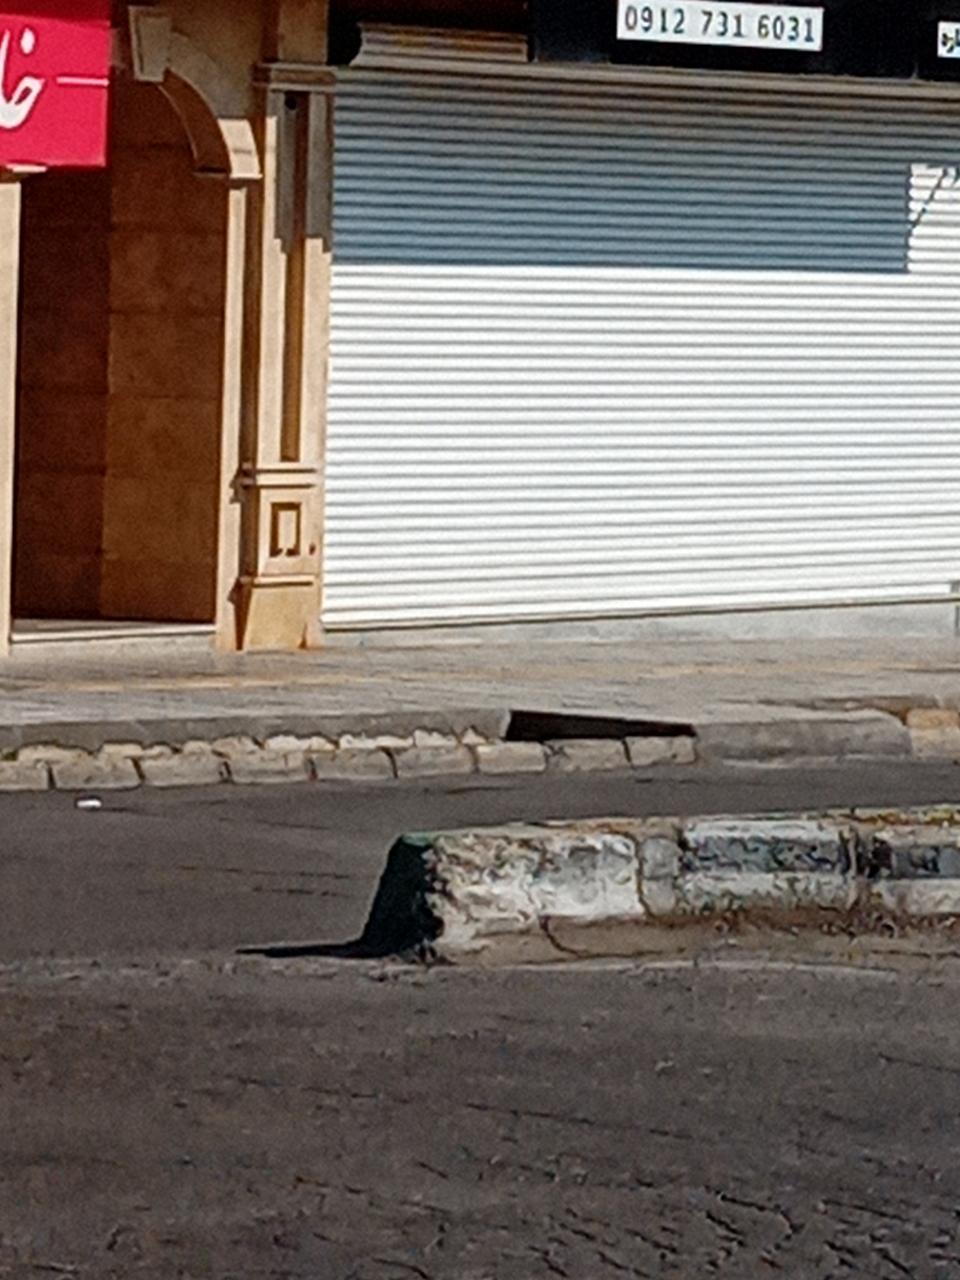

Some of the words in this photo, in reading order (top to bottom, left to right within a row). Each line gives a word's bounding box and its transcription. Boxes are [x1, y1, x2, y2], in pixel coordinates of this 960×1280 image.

[625, 5, 685, 34] 0912
[701, 10, 744, 38] 731
[757, 14, 815, 43] 6031
